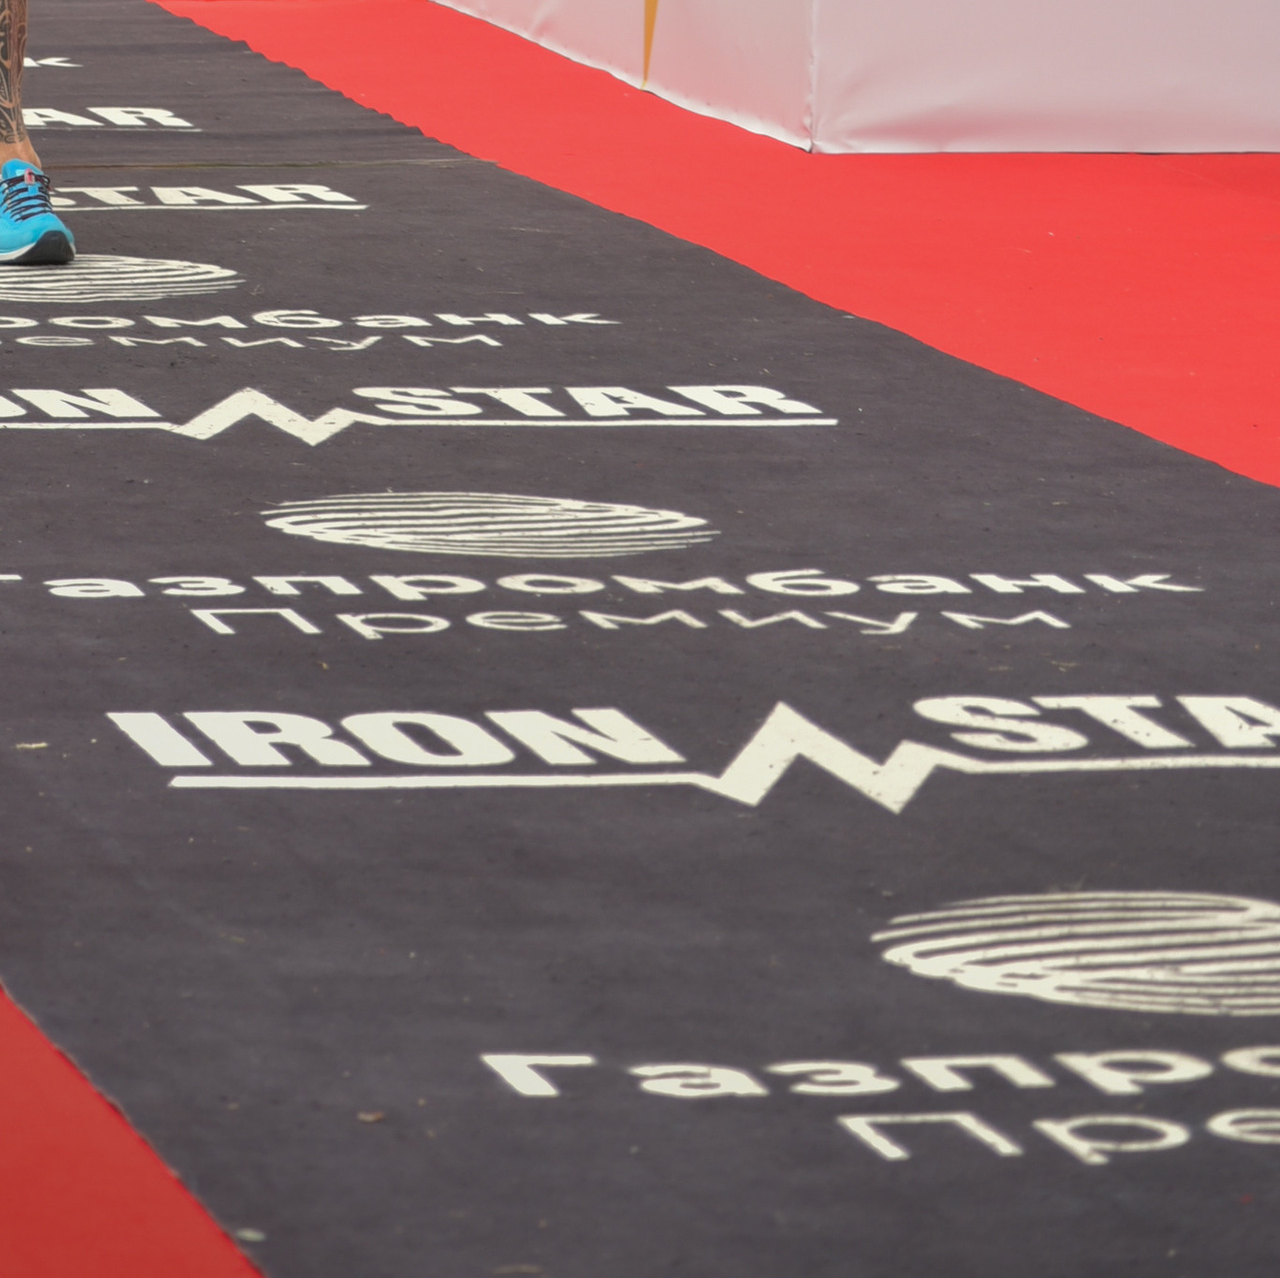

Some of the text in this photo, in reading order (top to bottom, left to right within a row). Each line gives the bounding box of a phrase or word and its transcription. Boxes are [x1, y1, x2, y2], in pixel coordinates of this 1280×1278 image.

[350, 384, 824, 417] STAR
[190, 605, 1073, 639] Премиум
[105, 708, 688, 766] IRON
